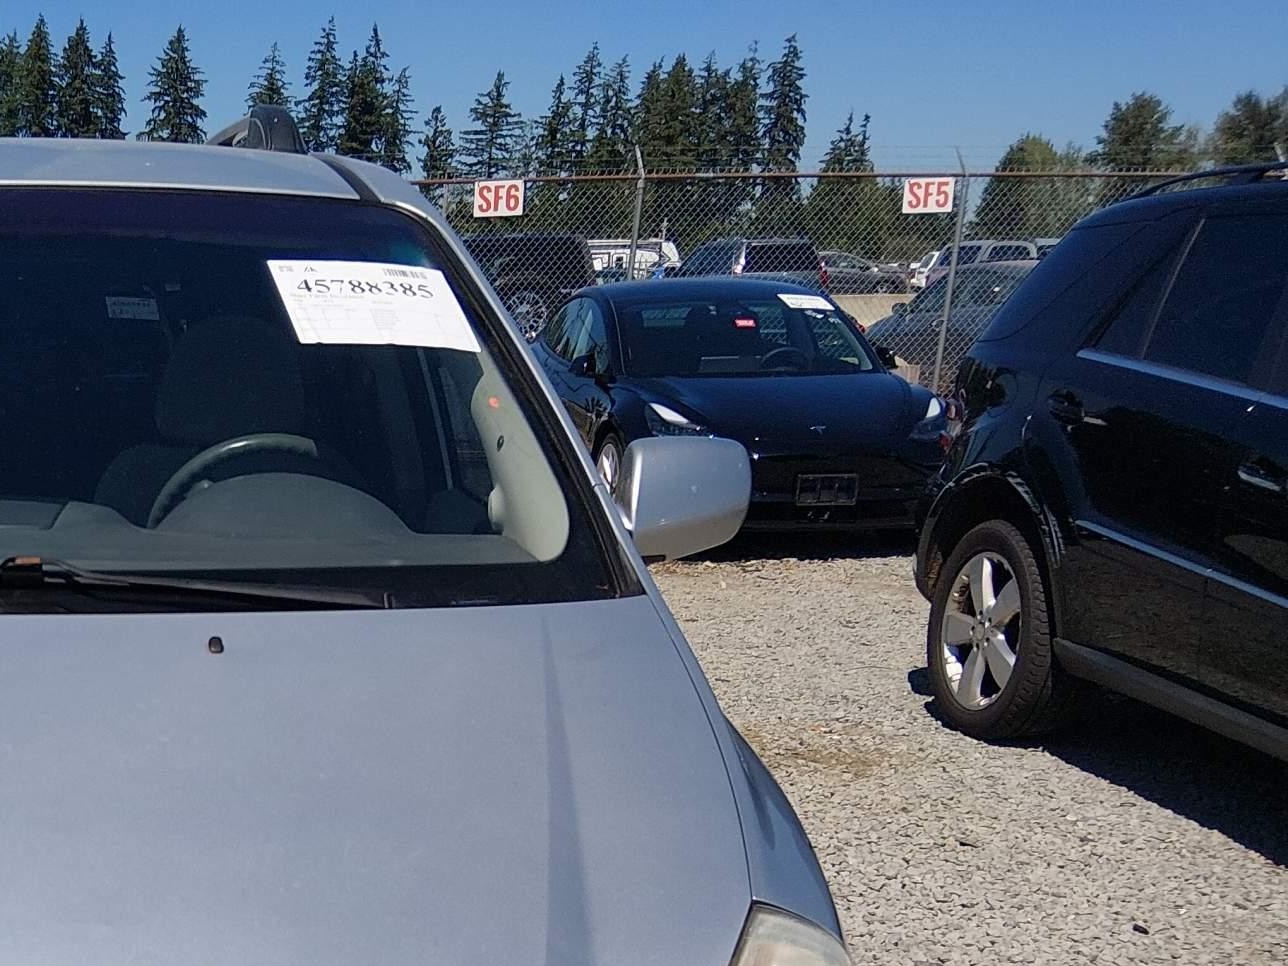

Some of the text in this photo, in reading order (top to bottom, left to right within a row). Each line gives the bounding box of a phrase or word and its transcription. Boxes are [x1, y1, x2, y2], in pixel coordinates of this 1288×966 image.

[478, 184, 520, 212] SF6
[908, 181, 950, 208] SF5
[296, 278, 434, 298] 45788385
